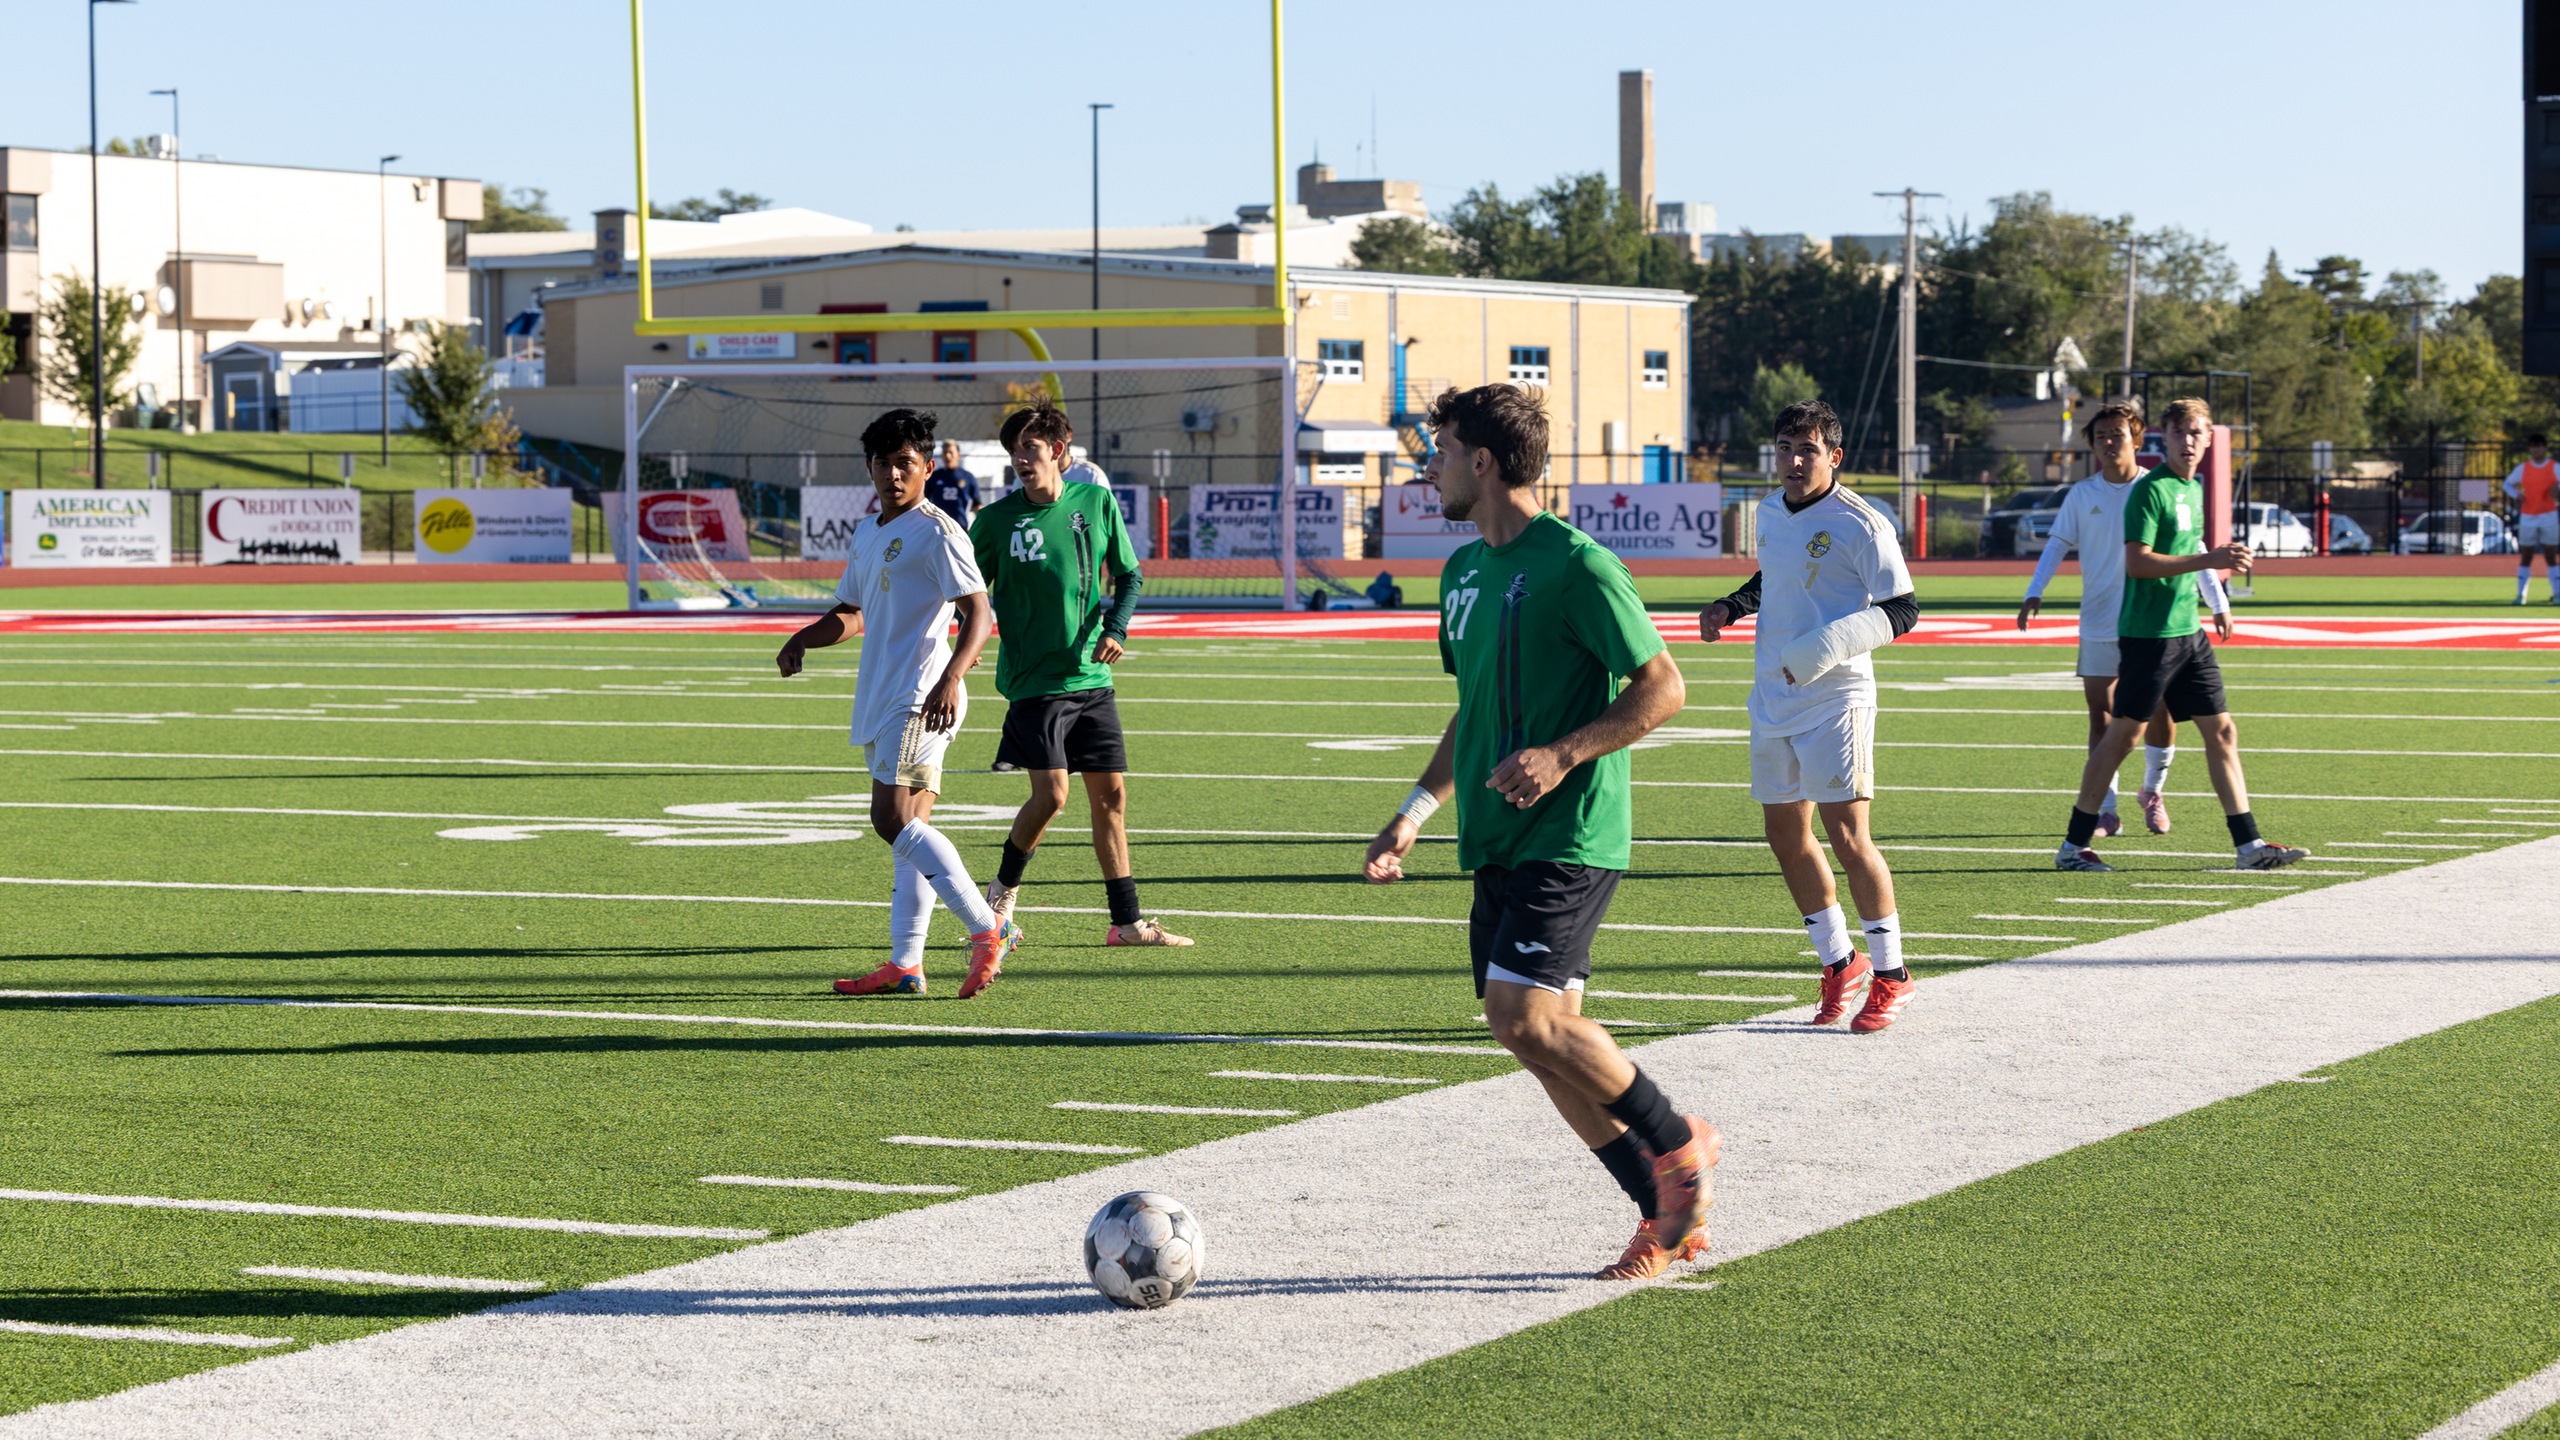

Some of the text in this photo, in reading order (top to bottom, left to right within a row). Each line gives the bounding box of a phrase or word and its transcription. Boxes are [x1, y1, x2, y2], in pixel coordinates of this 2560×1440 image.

[943, 487, 958, 500] 22
[1205, 490, 1333, 512] Pro-Tch
[33, 497, 150, 518] AMERICAN
[1196, 513, 1270, 526] Spraying
[48, 517, 136, 529] IMPLEMENT
[207, 496, 355, 544] CREDIT UNION
[281, 520, 322, 533] DODGE
[326, 520, 355, 533] CITY
[477, 515, 523, 525] Windows
[535, 515, 566, 525] Doors
[1574, 503, 1719, 549] Pride Ag
[1010, 528, 1047, 562] 42
[880, 566, 891, 593] 6
[1805, 561, 1820, 590] 7
[1445, 587, 1480, 641] 27
[1138, 1283, 1167, 1309] SEL
